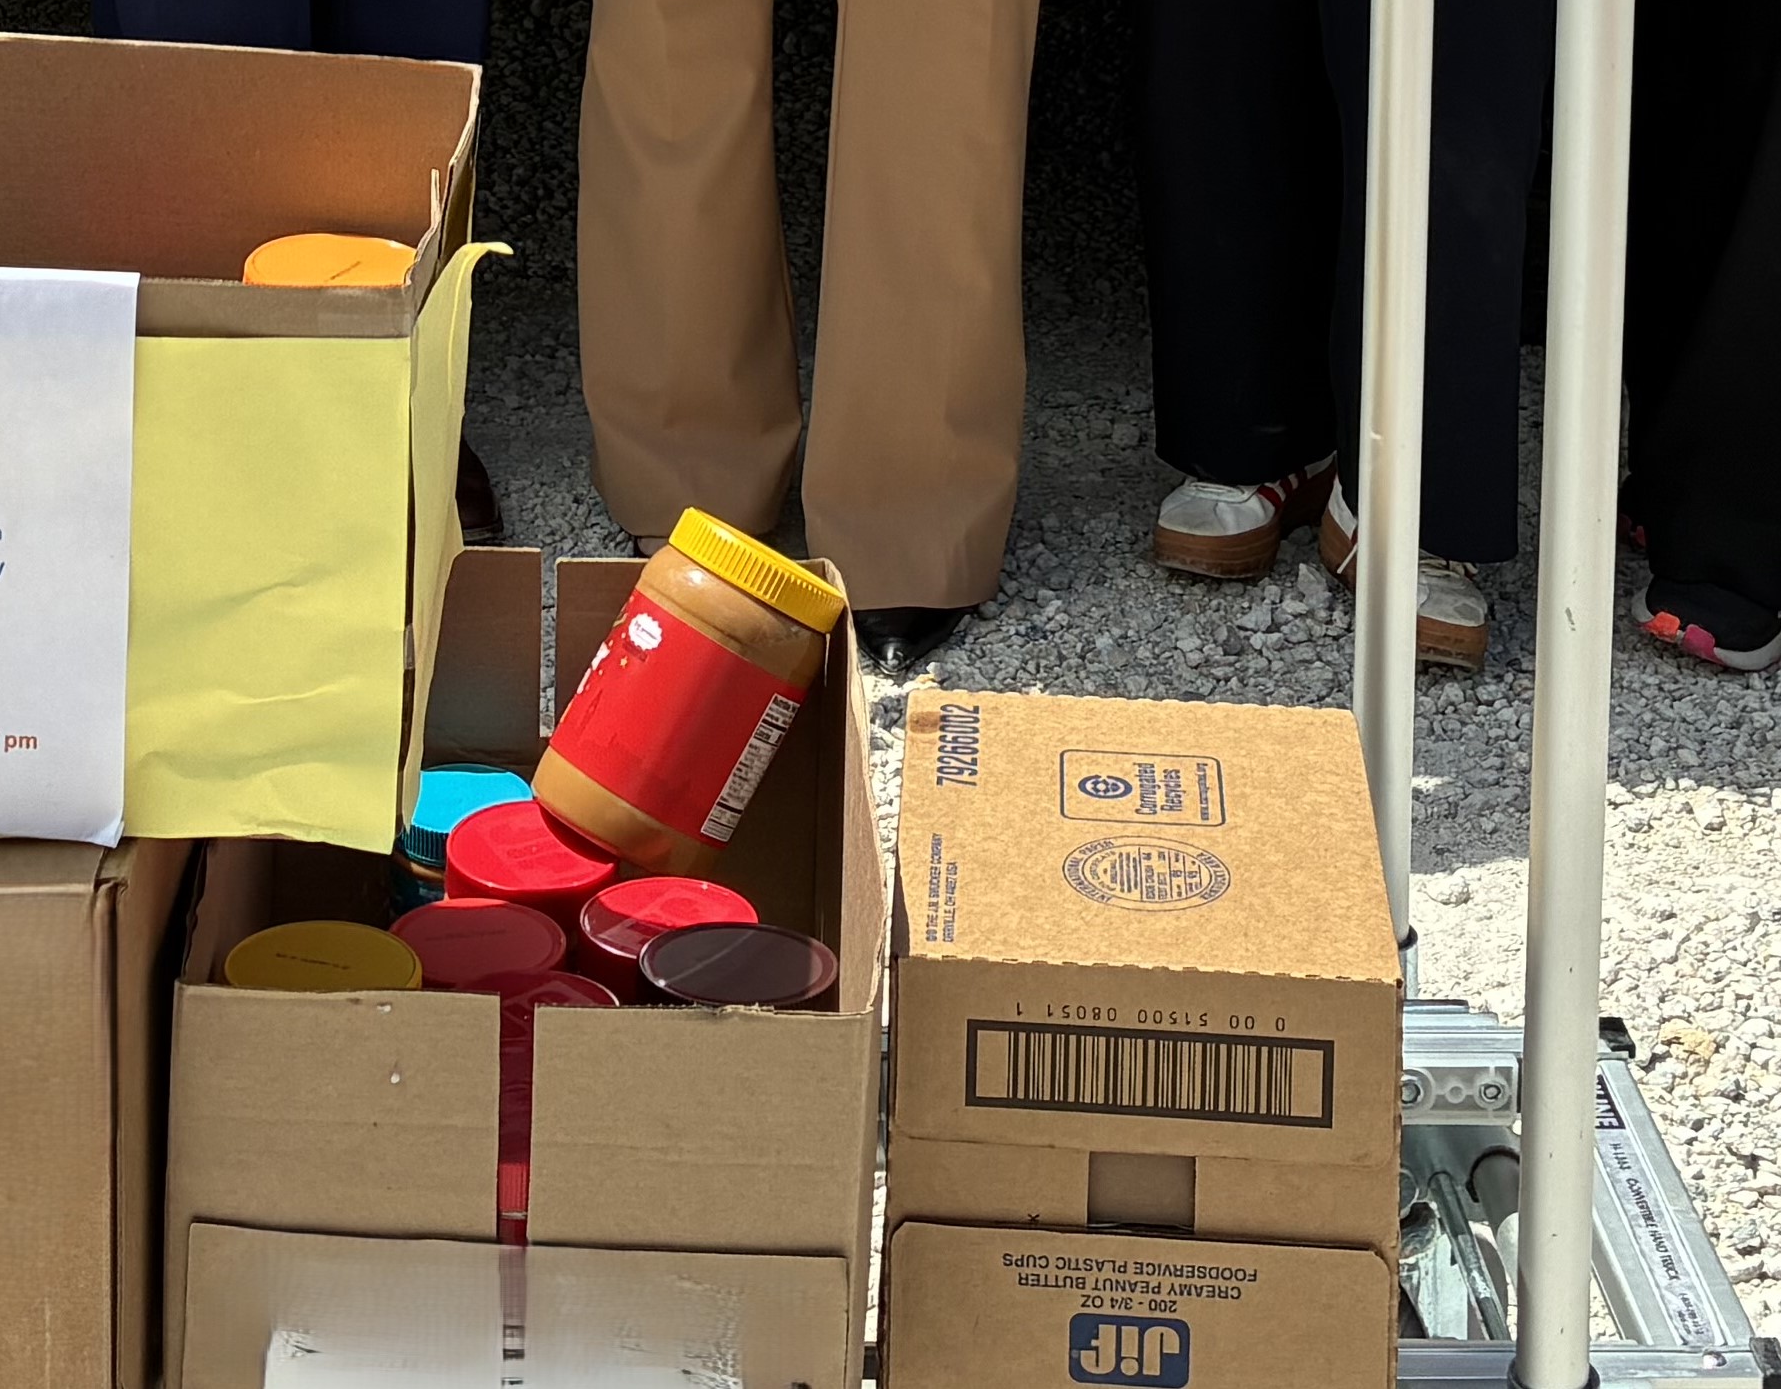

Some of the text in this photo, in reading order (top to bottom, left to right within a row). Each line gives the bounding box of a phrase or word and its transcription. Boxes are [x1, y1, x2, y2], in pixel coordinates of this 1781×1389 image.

[3, 736, 39, 753] pm
[936, 703, 981, 788] 79266002
[1134, 762, 1158, 815] Corrugated
[1160, 768, 1184, 811] Recycles
[1015, 1002, 1286, 1032] 0 00 51500 08051 1
[1001, 1253, 1258, 1283] FOODSERVICE PLASTIC CUPS
[1017, 1273, 1241, 1300] CREAMY PEANUT BUTTER
[1080, 1294, 1104, 1309] OZ
[1108, 1296, 1133, 1311] 3/4
[1148, 1299, 1178, 1313] 200
[1079, 1323, 1181, 1377] Jif
